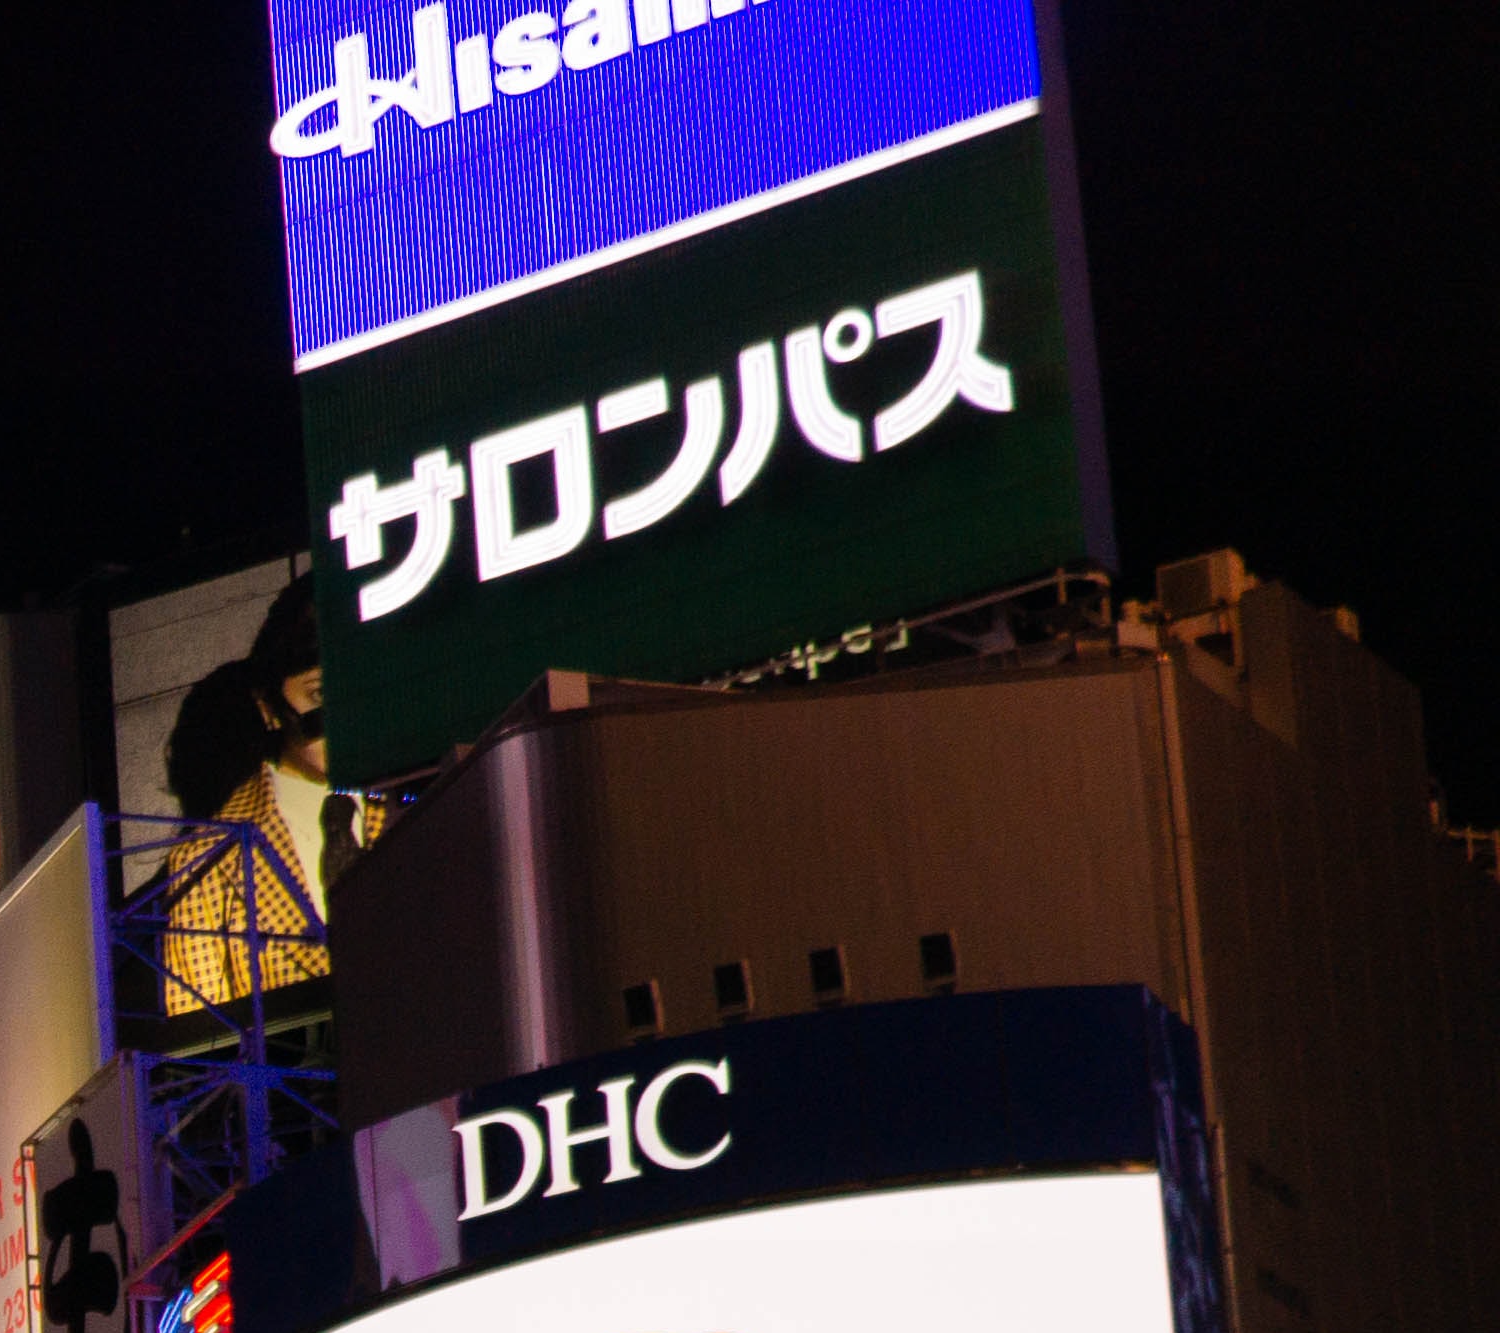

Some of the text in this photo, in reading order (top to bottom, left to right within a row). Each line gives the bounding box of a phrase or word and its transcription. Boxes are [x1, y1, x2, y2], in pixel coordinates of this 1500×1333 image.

[329, 271, 1015, 622] サロンパス
[452, 1056, 731, 1222] DHC
